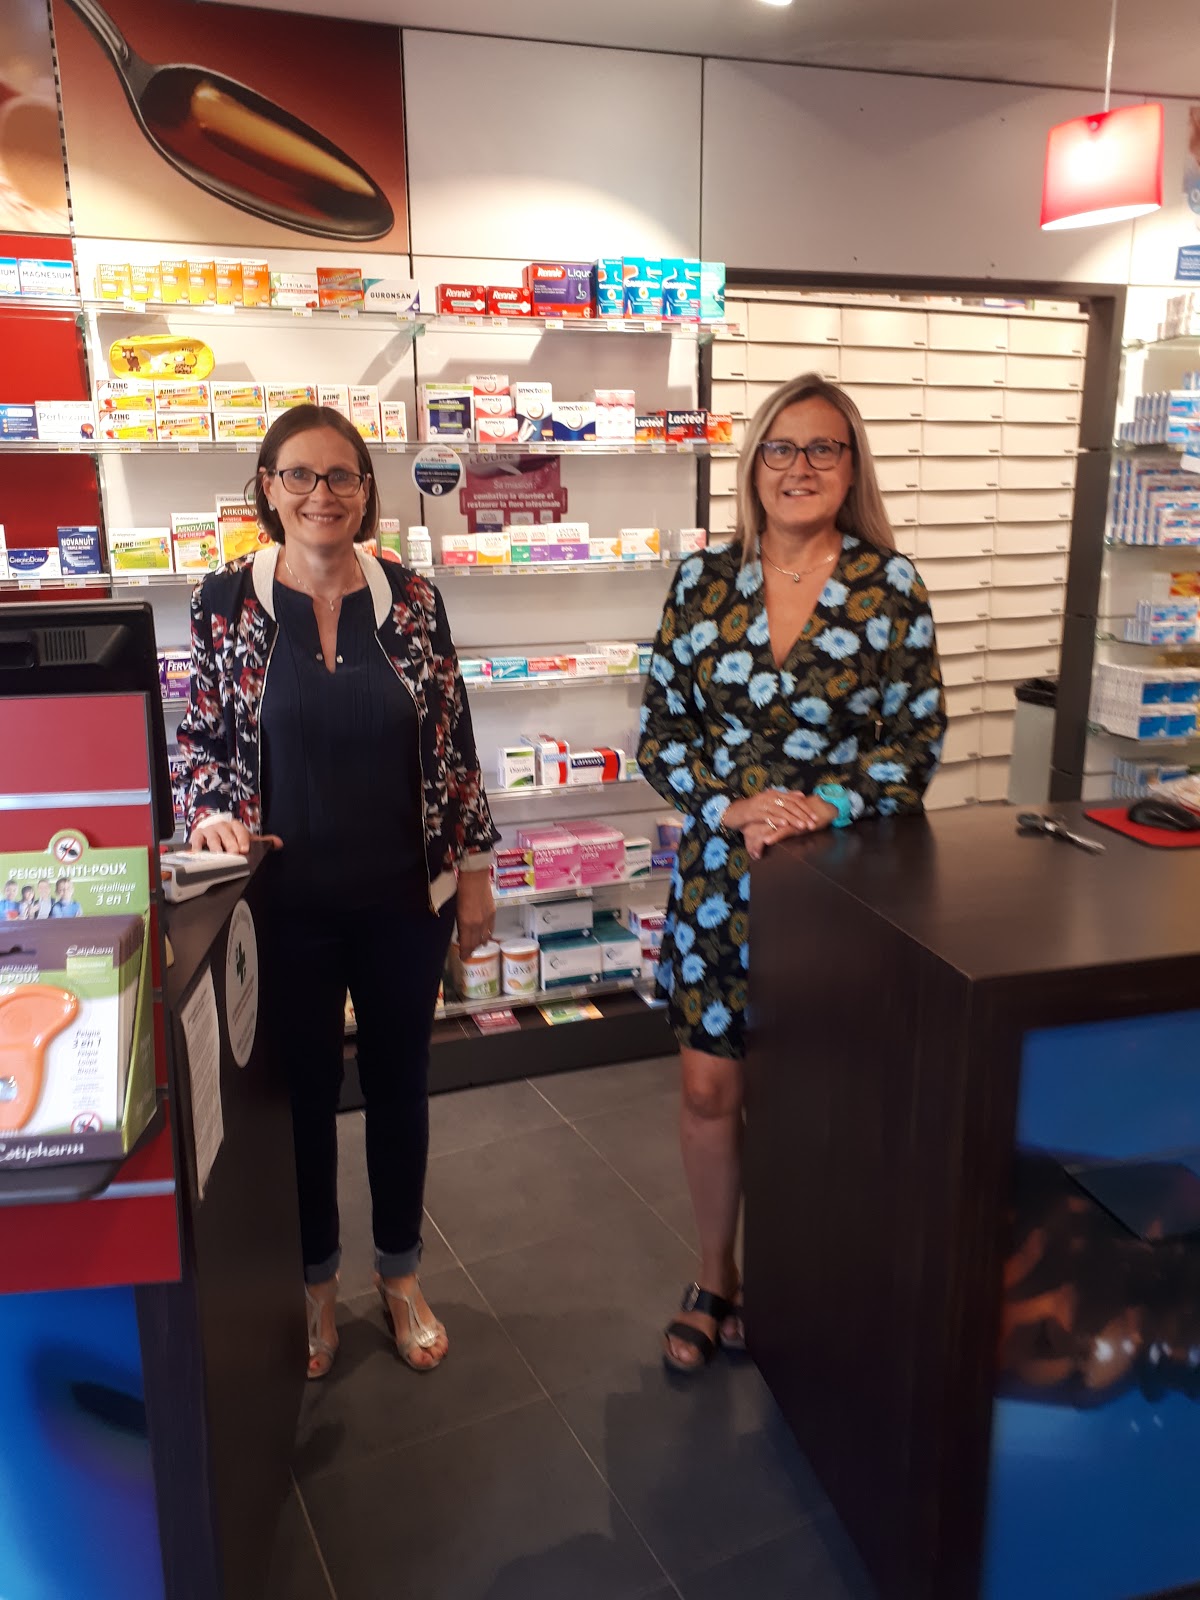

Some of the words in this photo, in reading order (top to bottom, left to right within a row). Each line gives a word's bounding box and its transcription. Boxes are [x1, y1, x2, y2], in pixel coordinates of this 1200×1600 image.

[22, 270, 72, 279] MAGNESIUM
[536, 267, 563, 278] Rennie
[370, 291, 412, 300] GURONSAN
[445, 287, 472, 299] Rennie
[493, 289, 518, 301] Rennie
[107, 382, 129, 390] AZINC
[322, 393, 341, 401] AZINC
[352, 394, 371, 402] AZINC
[473, 492, 508, 500] combattre
[509, 492, 517, 500] la
[546, 492, 555, 500] et
[467, 501, 499, 509] restaurer
[525, 500, 561, 508] intestinale
[177, 522, 215, 533] ARKOVITAL
[61, 537, 95, 546] NOVANUIT
[115, 541, 134, 550] AZINC
[8, 867, 55, 880] PEIGNE
[58, 862, 127, 878] ANTI-POUX
[90, 882, 136, 894] métallique
[96, 895, 104, 906] 3
[106, 895, 122, 905] en
[125, 892, 131, 904] 1
[72, 1040, 79, 1049] 3
[81, 1040, 94, 1048] en
